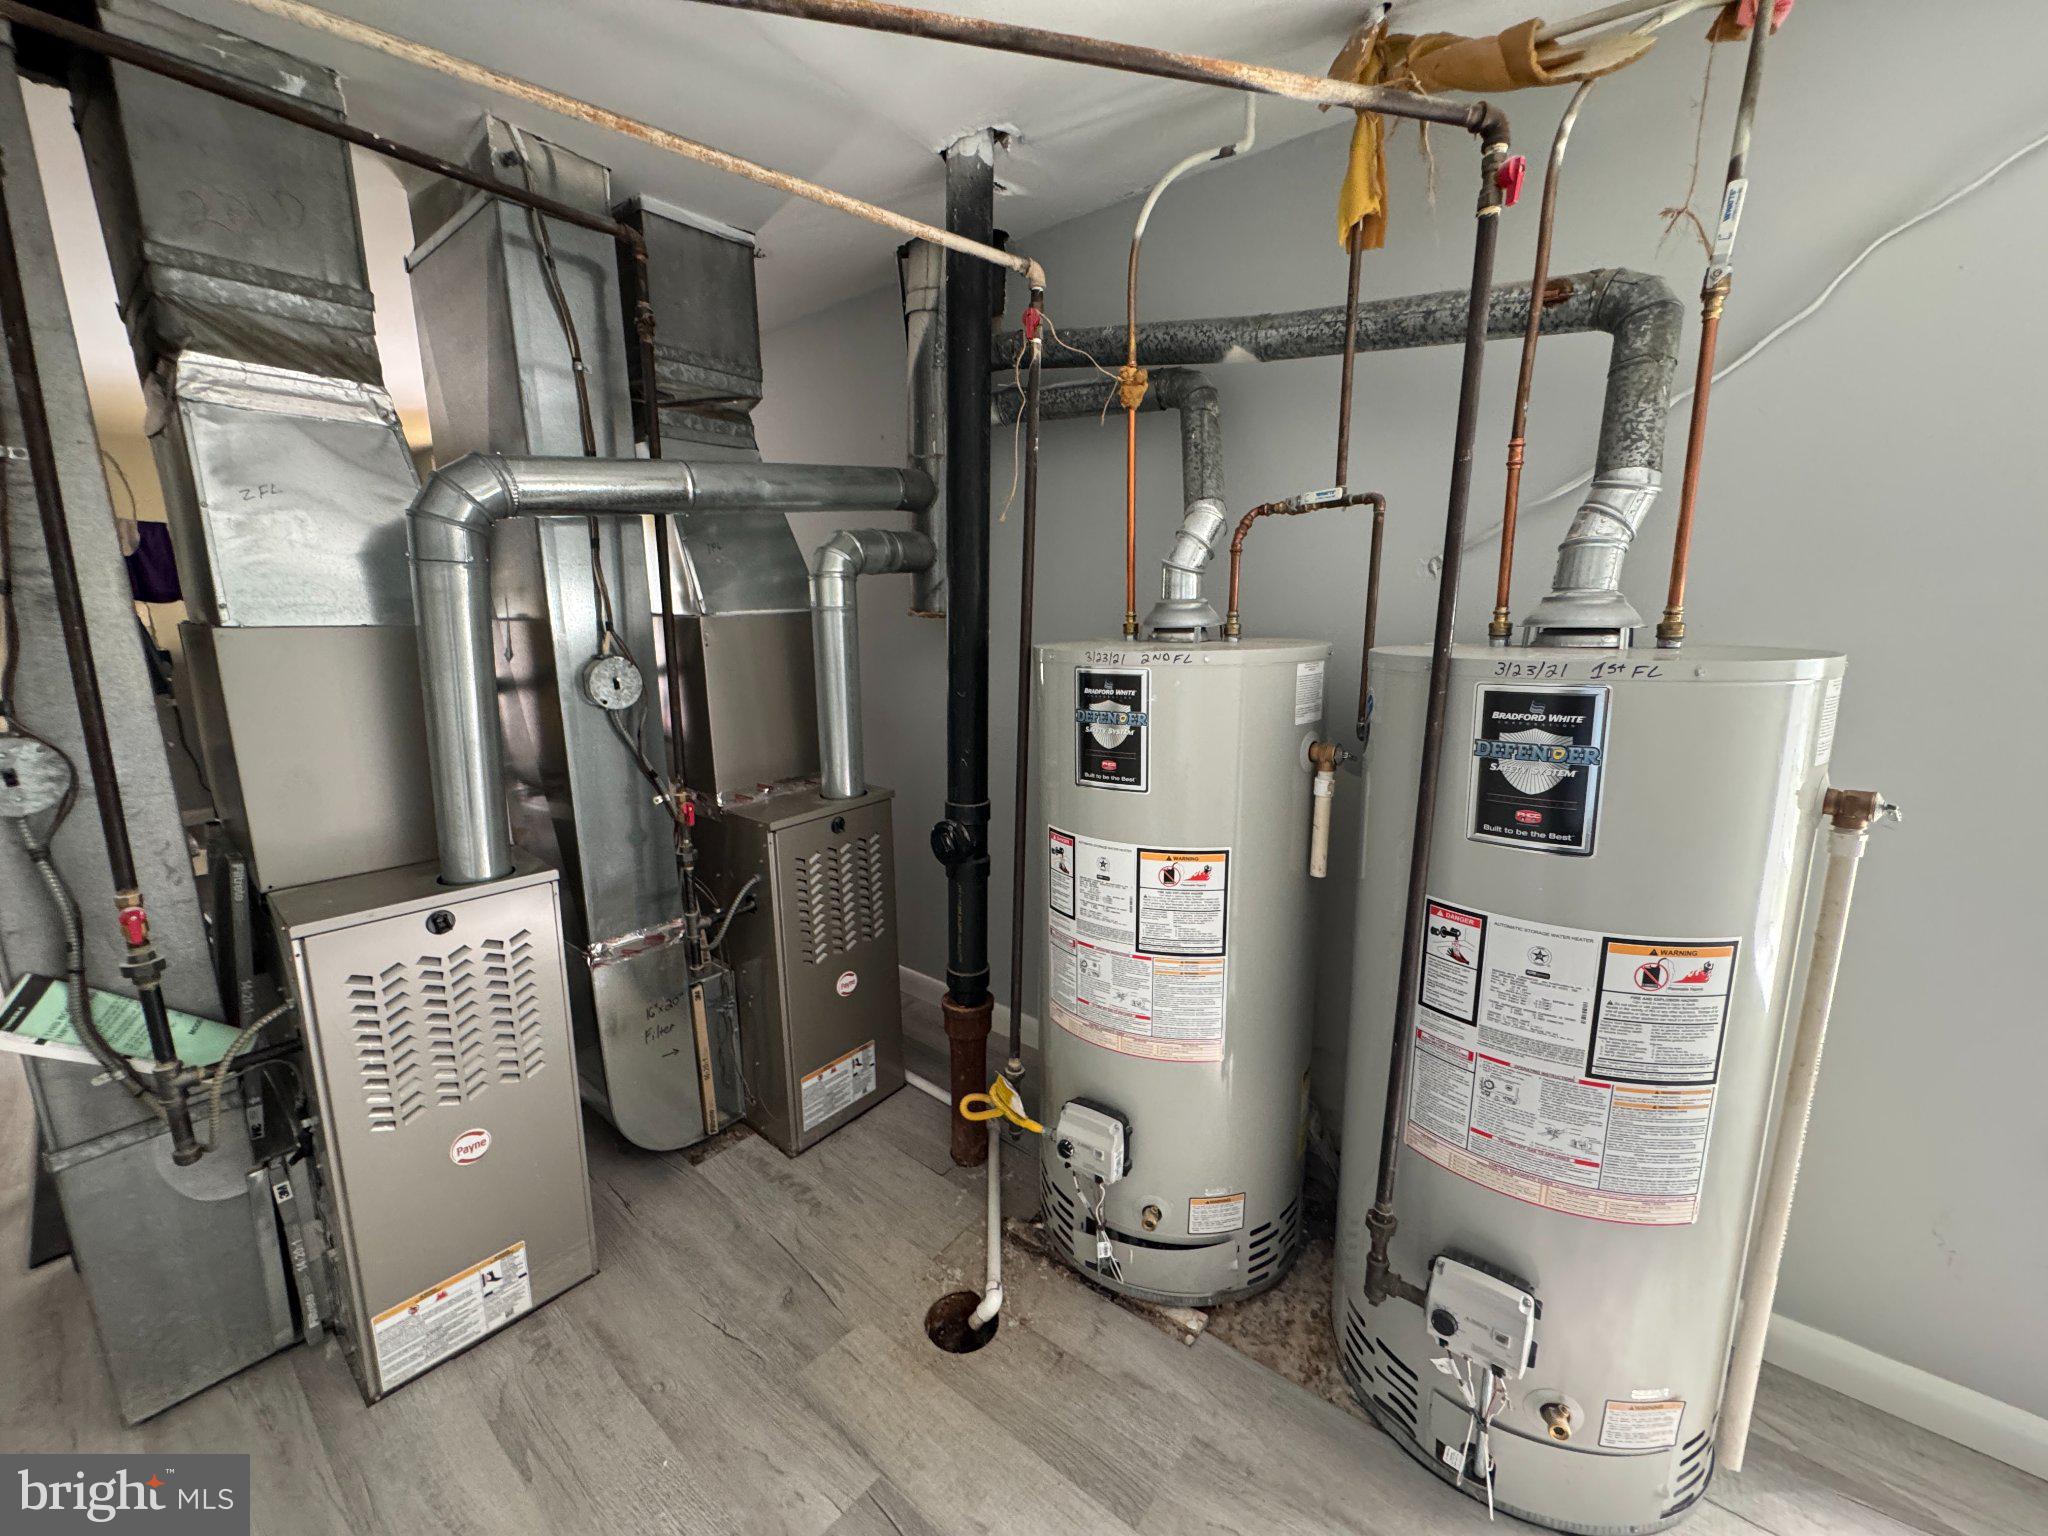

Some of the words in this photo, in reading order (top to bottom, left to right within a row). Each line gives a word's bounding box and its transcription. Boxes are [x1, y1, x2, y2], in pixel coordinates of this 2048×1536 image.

[1085, 651, 1126, 665] 3/23/21
[1172, 654, 1192, 665] FL
[1494, 661, 1568, 680] 3/23/21
[1631, 665, 1663, 679] FL
[1084, 687, 1114, 696] BRADFORD
[1115, 689, 1137, 697] WHITE
[1075, 708, 1149, 727] DEFENDER
[1492, 711, 1547, 722] BRADFORD
[1548, 714, 1584, 724] WHITE
[1474, 739, 1601, 766] DEFENDER
[1530, 766, 1577, 778] SYSTEM
[1483, 824, 1502, 833] Built
[1515, 828, 1528, 836] be
[1548, 833, 1572, 841] Best
[1445, 911, 1474, 925] DANGER
[1494, 921, 1523, 932] AUTOMATIC
[1660, 949, 1698, 957] WARNING
[644, 1023, 676, 1044] Filter
[456, 1138, 487, 1156] Payne
